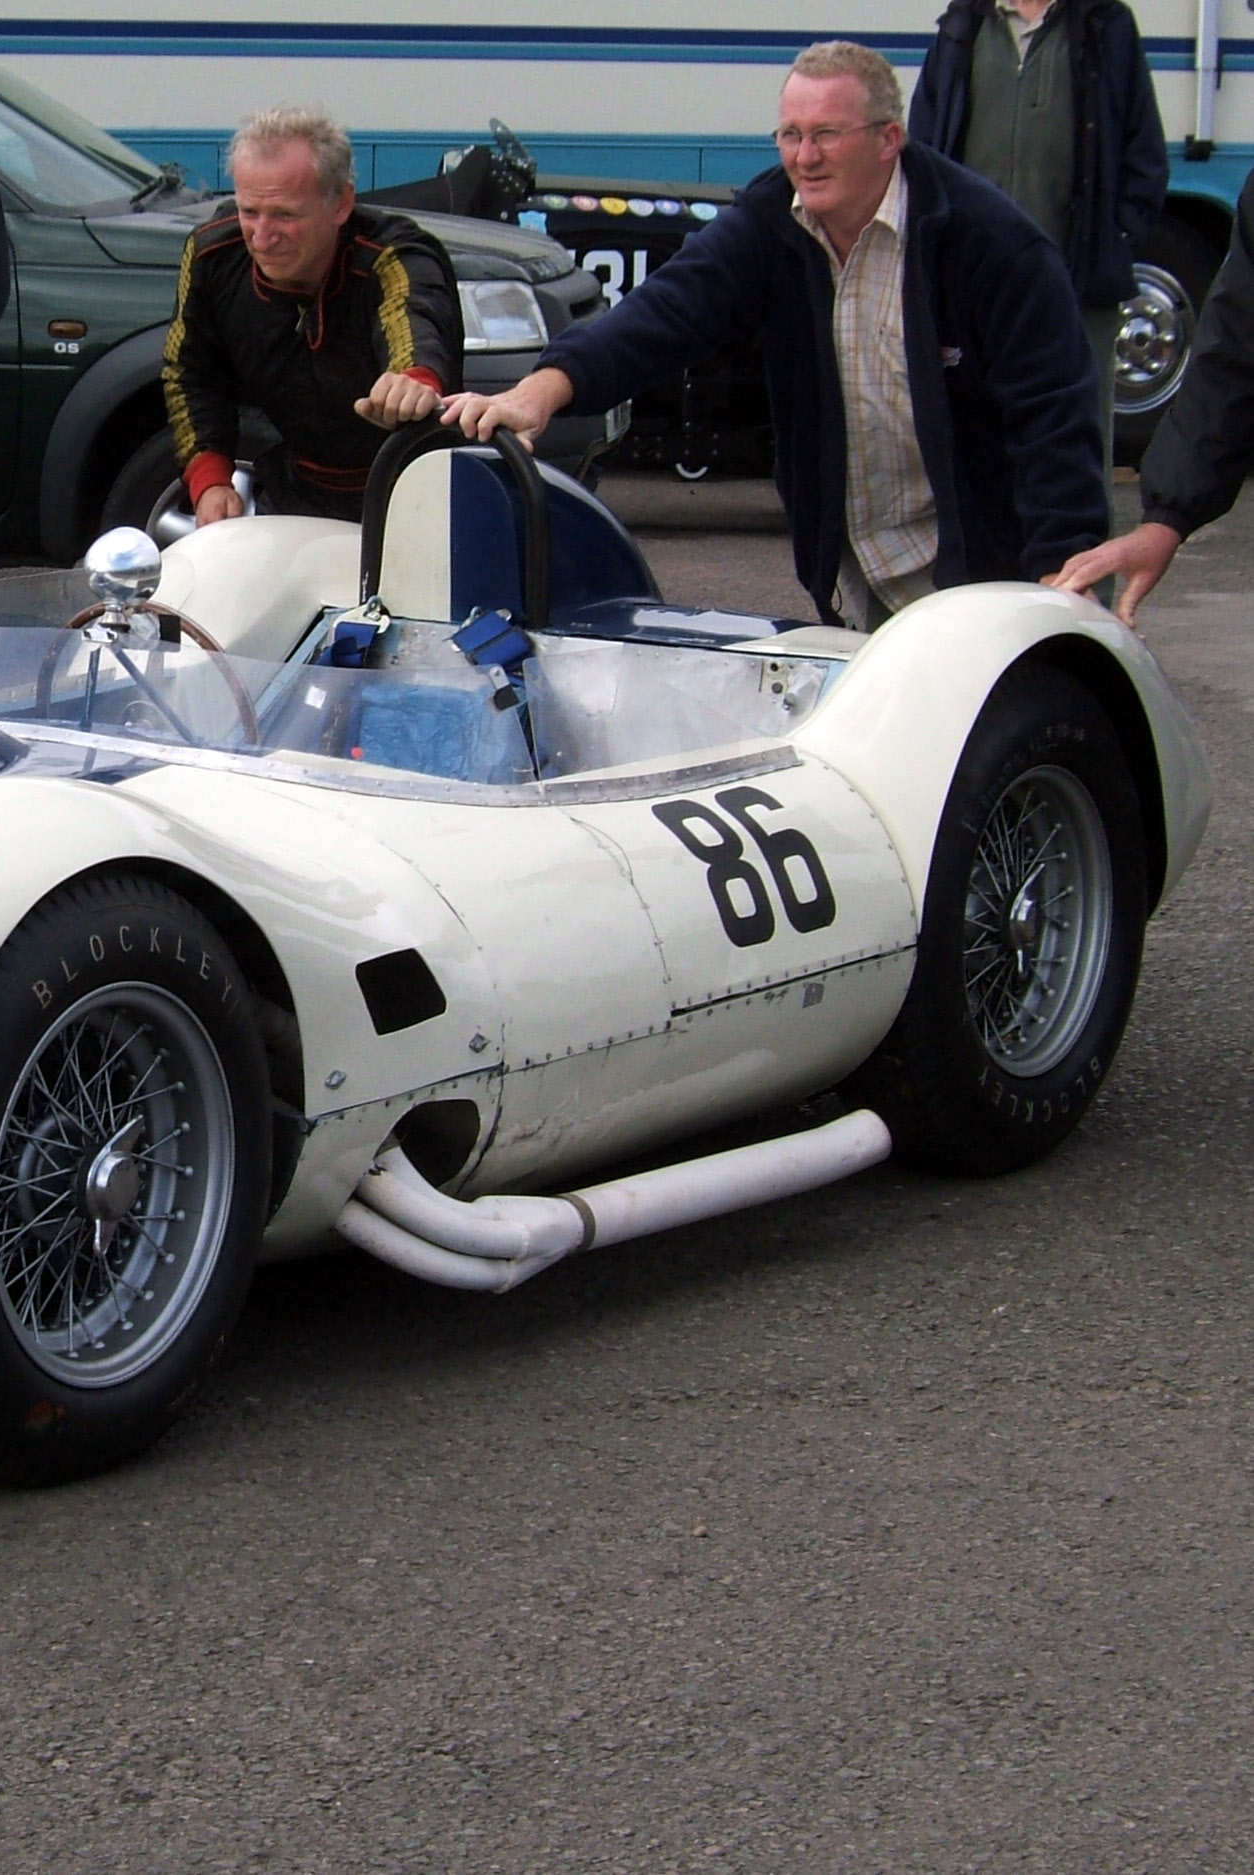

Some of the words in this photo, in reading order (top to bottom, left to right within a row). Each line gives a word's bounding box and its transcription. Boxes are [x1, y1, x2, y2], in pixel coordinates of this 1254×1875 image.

[651, 786, 837, 948] 86
[32, 926, 233, 1009] BLOCKLEY
[978, 1056, 1102, 1123] BLOCKLEY
